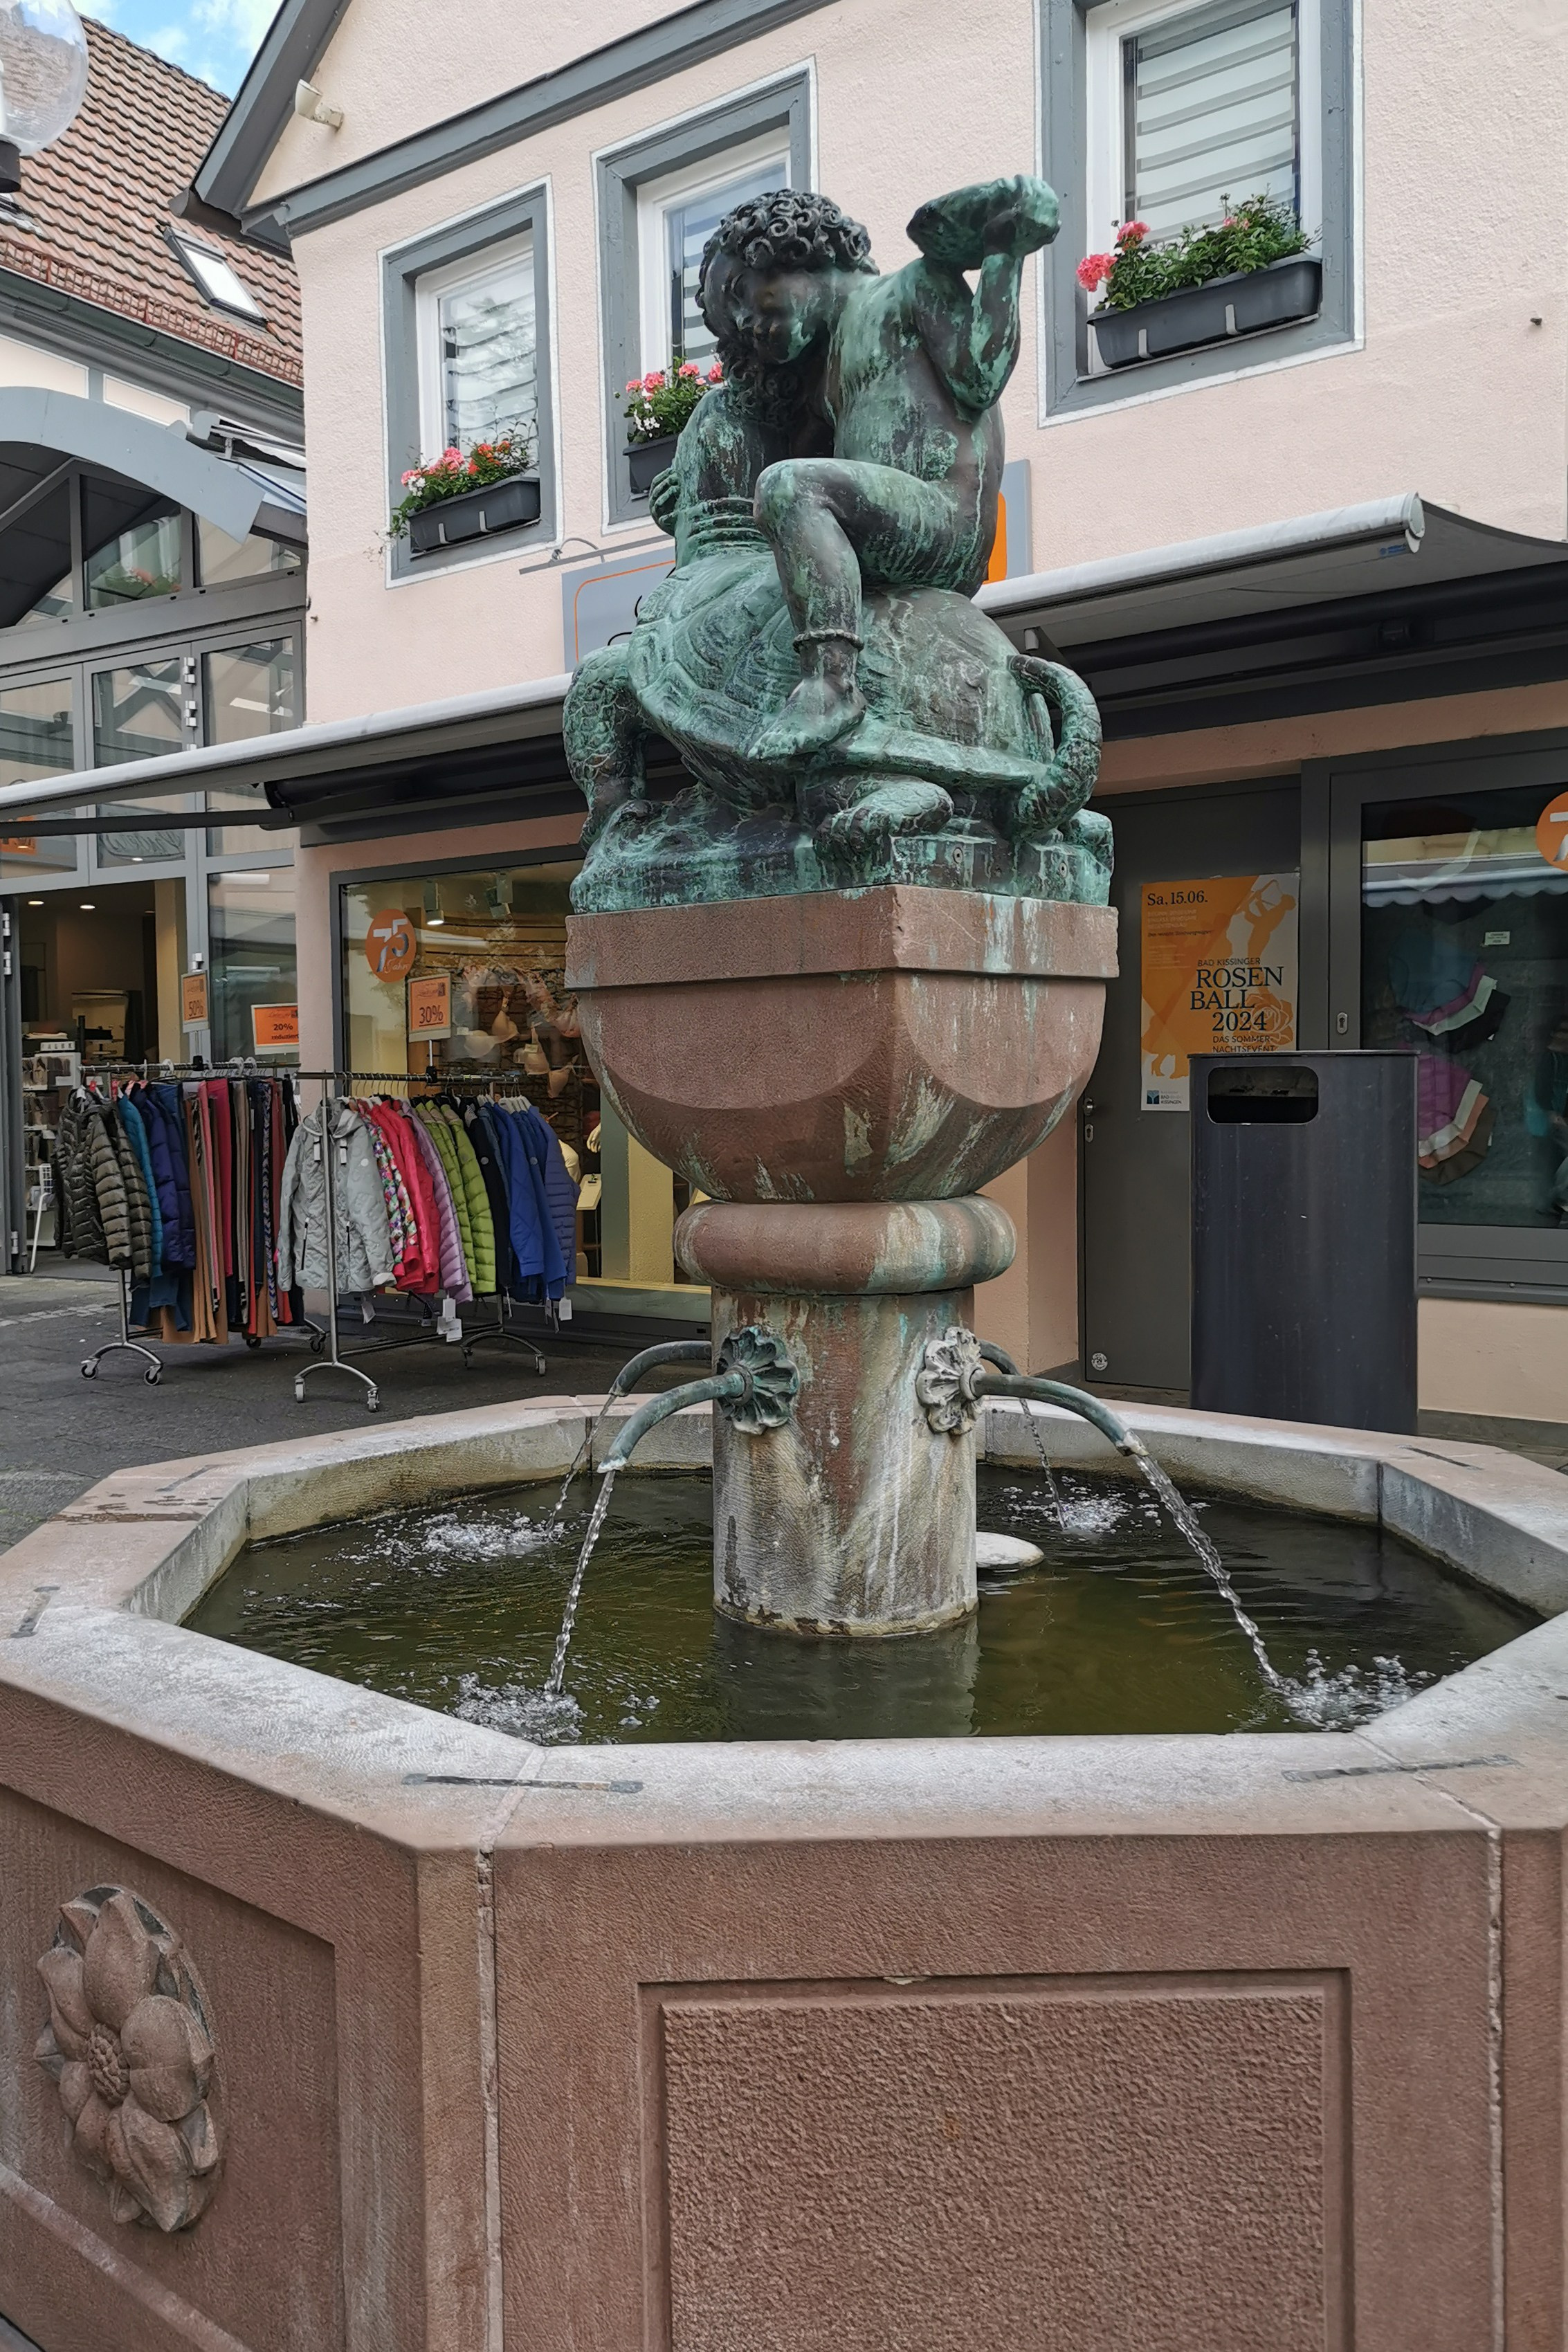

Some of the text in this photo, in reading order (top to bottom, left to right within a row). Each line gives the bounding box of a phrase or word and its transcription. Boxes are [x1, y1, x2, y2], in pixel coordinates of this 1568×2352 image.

[1147, 891, 1208, 906] Sa. 15.06.
[373, 918, 409, 972] 75
[1216, 958, 1261, 966] KISSINGER
[1196, 967, 1284, 989] ROSEN
[188, 1000, 204, 1017] 50%
[1190, 990, 1255, 1010] BALL
[419, 1005, 444, 1024] 30%
[1212, 1011, 1267, 1031] 2024
